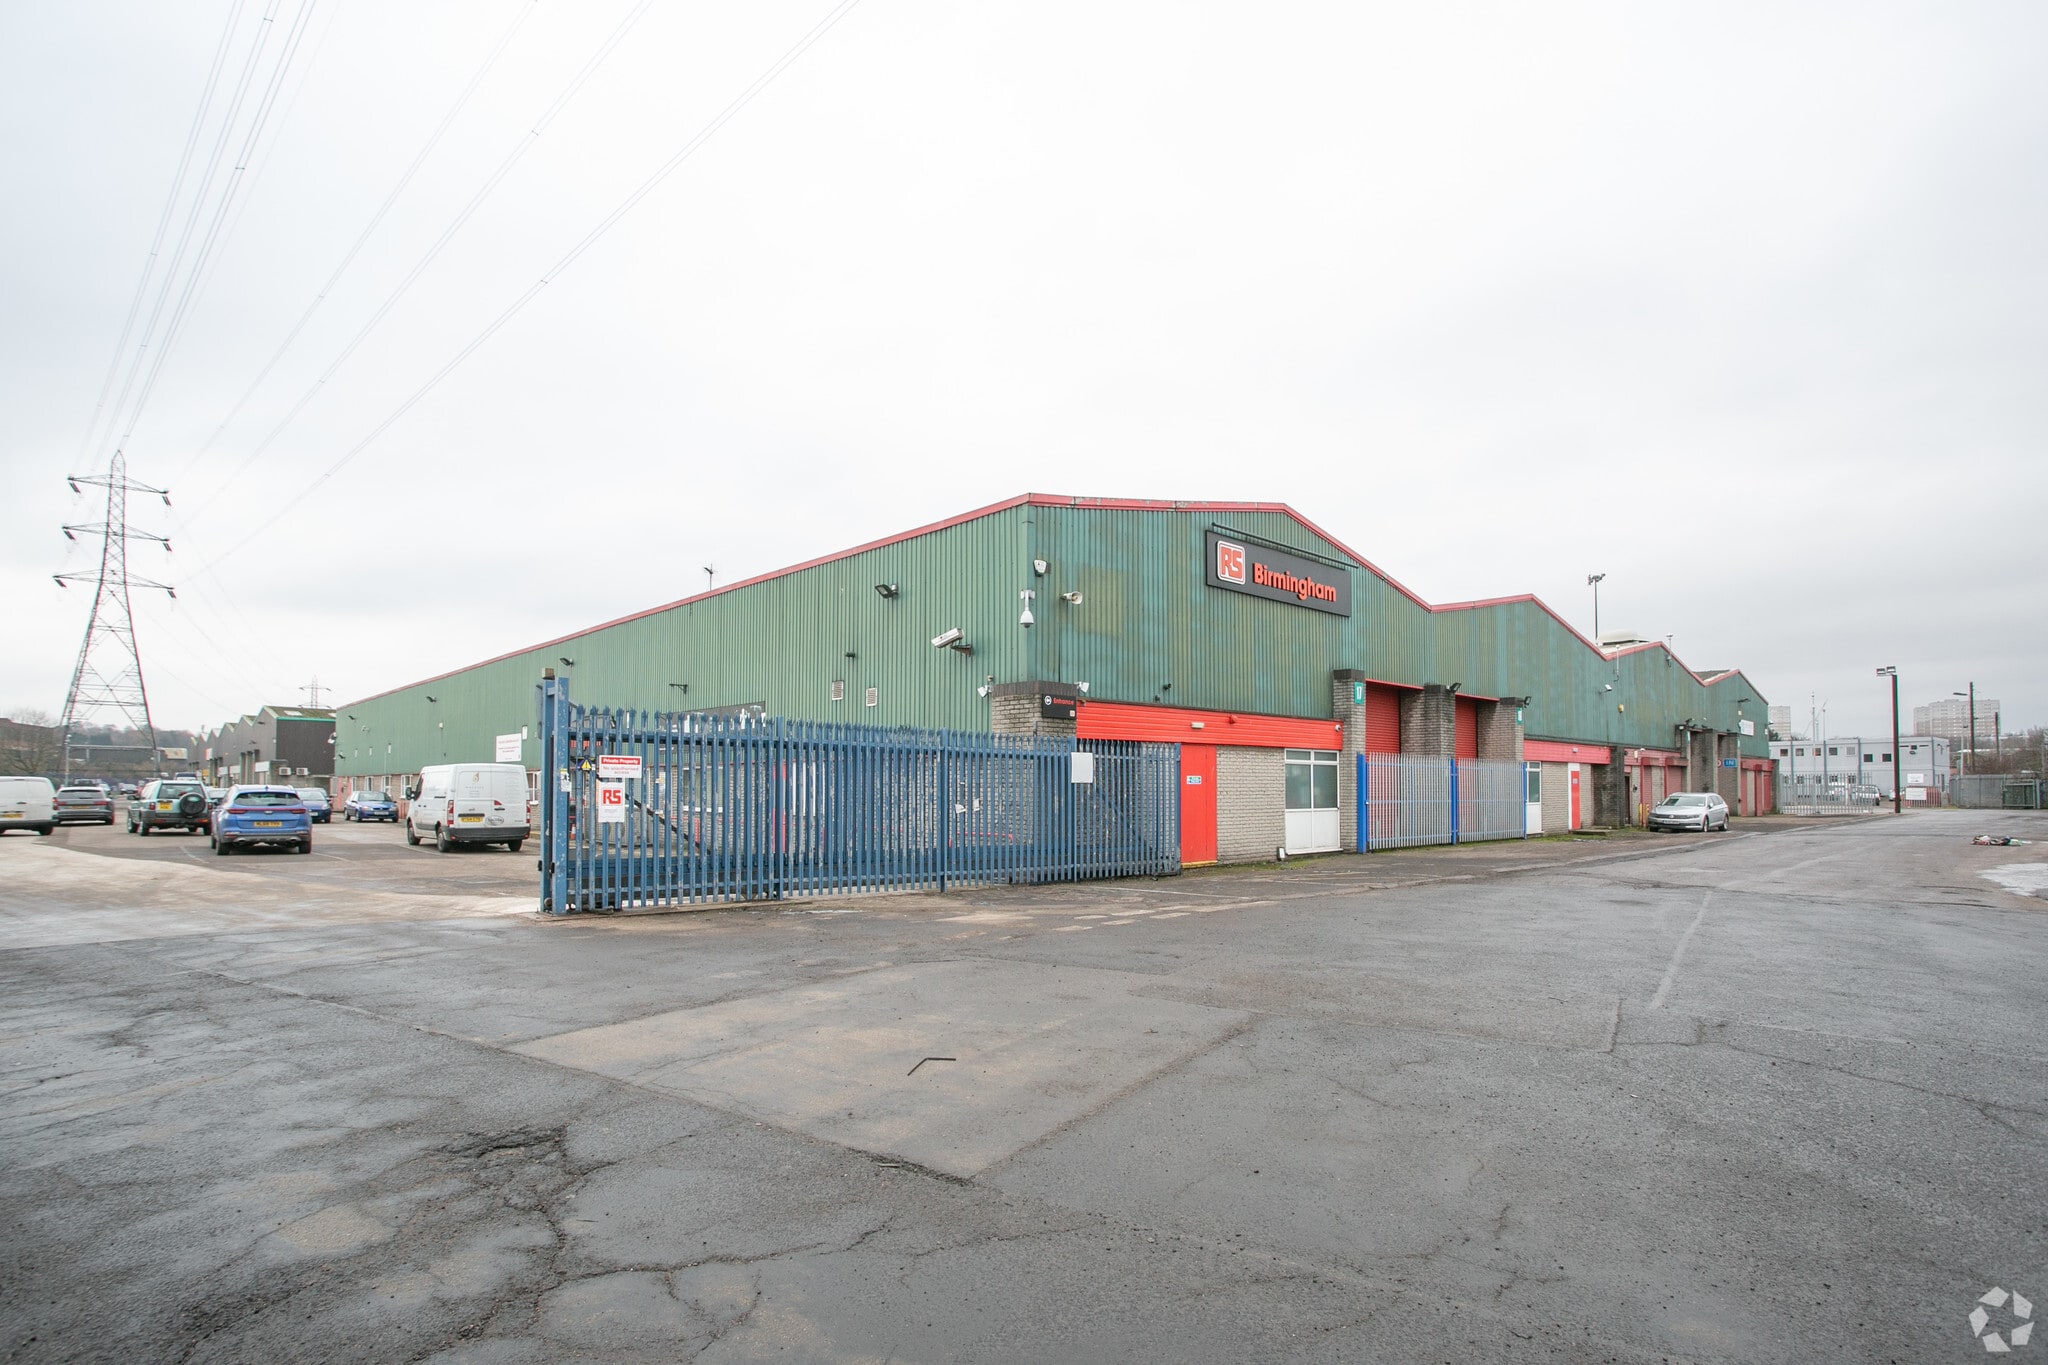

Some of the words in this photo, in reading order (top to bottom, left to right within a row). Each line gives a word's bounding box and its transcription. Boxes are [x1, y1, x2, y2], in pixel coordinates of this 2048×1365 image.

[1221, 546, 1243, 579] RS
[1254, 562, 1336, 601] Birmingham
[602, 789, 621, 804] RS
